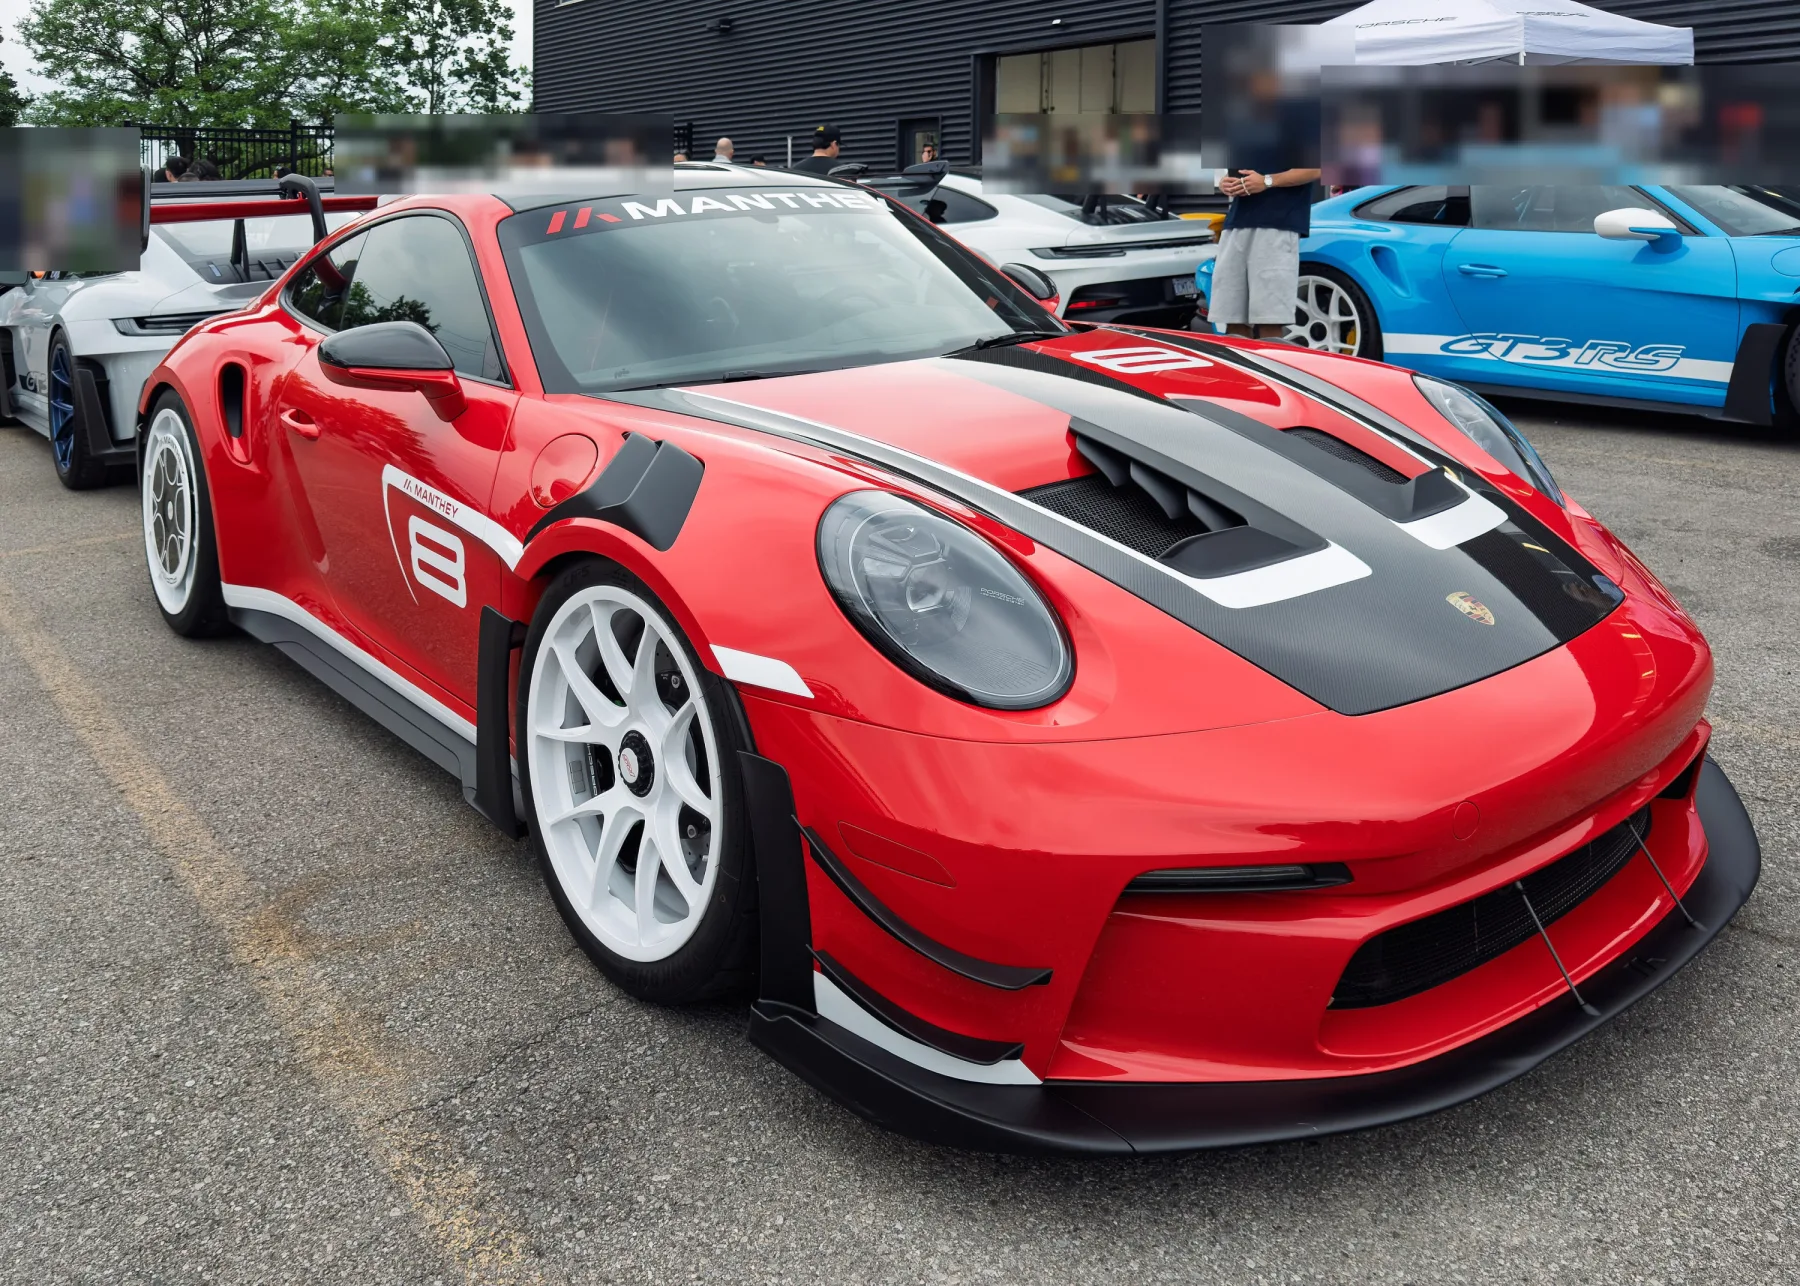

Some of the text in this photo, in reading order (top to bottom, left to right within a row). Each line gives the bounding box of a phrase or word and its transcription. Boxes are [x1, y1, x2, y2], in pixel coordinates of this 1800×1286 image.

[1355, 16, 1458, 29] ORSCHE
[1070, 346, 1214, 374] 8
[413, 483, 459, 518] MANTHEY
[408, 514, 467, 609] 8
[980, 587, 1025, 603] PORSCHE
